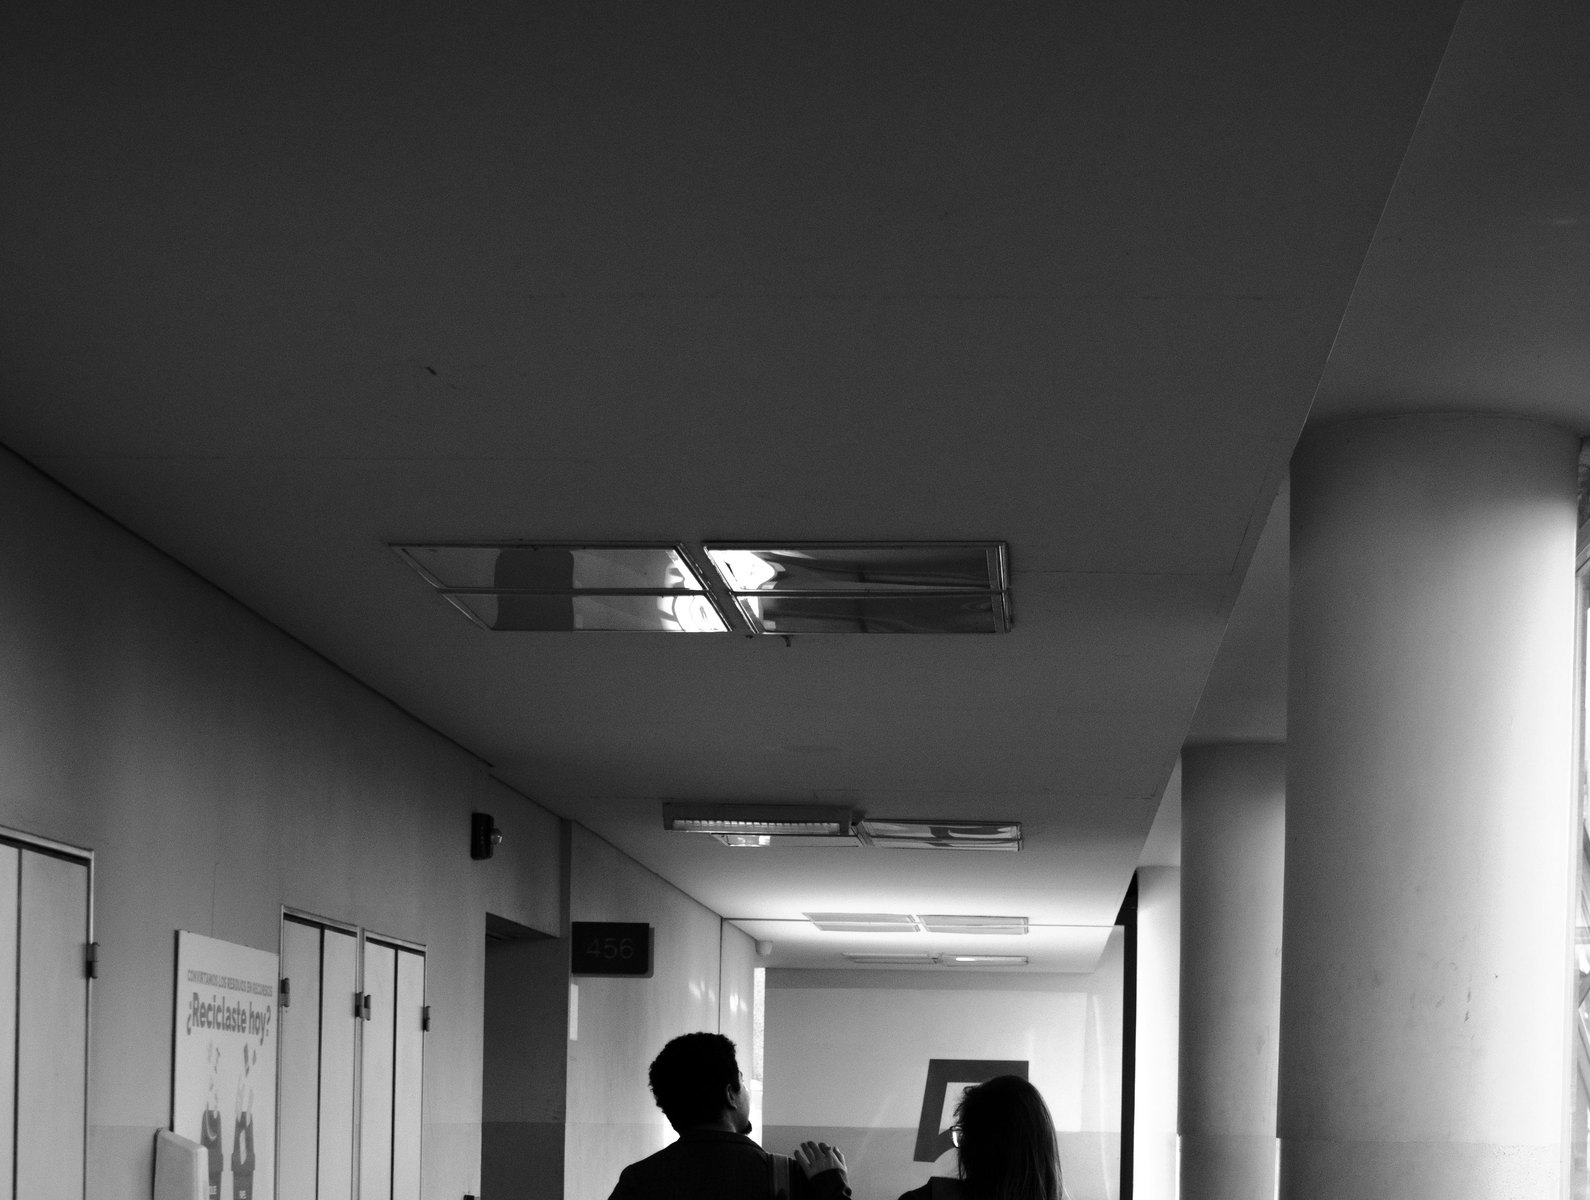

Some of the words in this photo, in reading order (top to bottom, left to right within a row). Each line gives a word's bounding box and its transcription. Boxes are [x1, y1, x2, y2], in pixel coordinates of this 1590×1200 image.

[585, 937, 634, 960] 456
[186, 992, 247, 1036] ¿Reciclaste
[248, 1001, 272, 1046] hoy?
